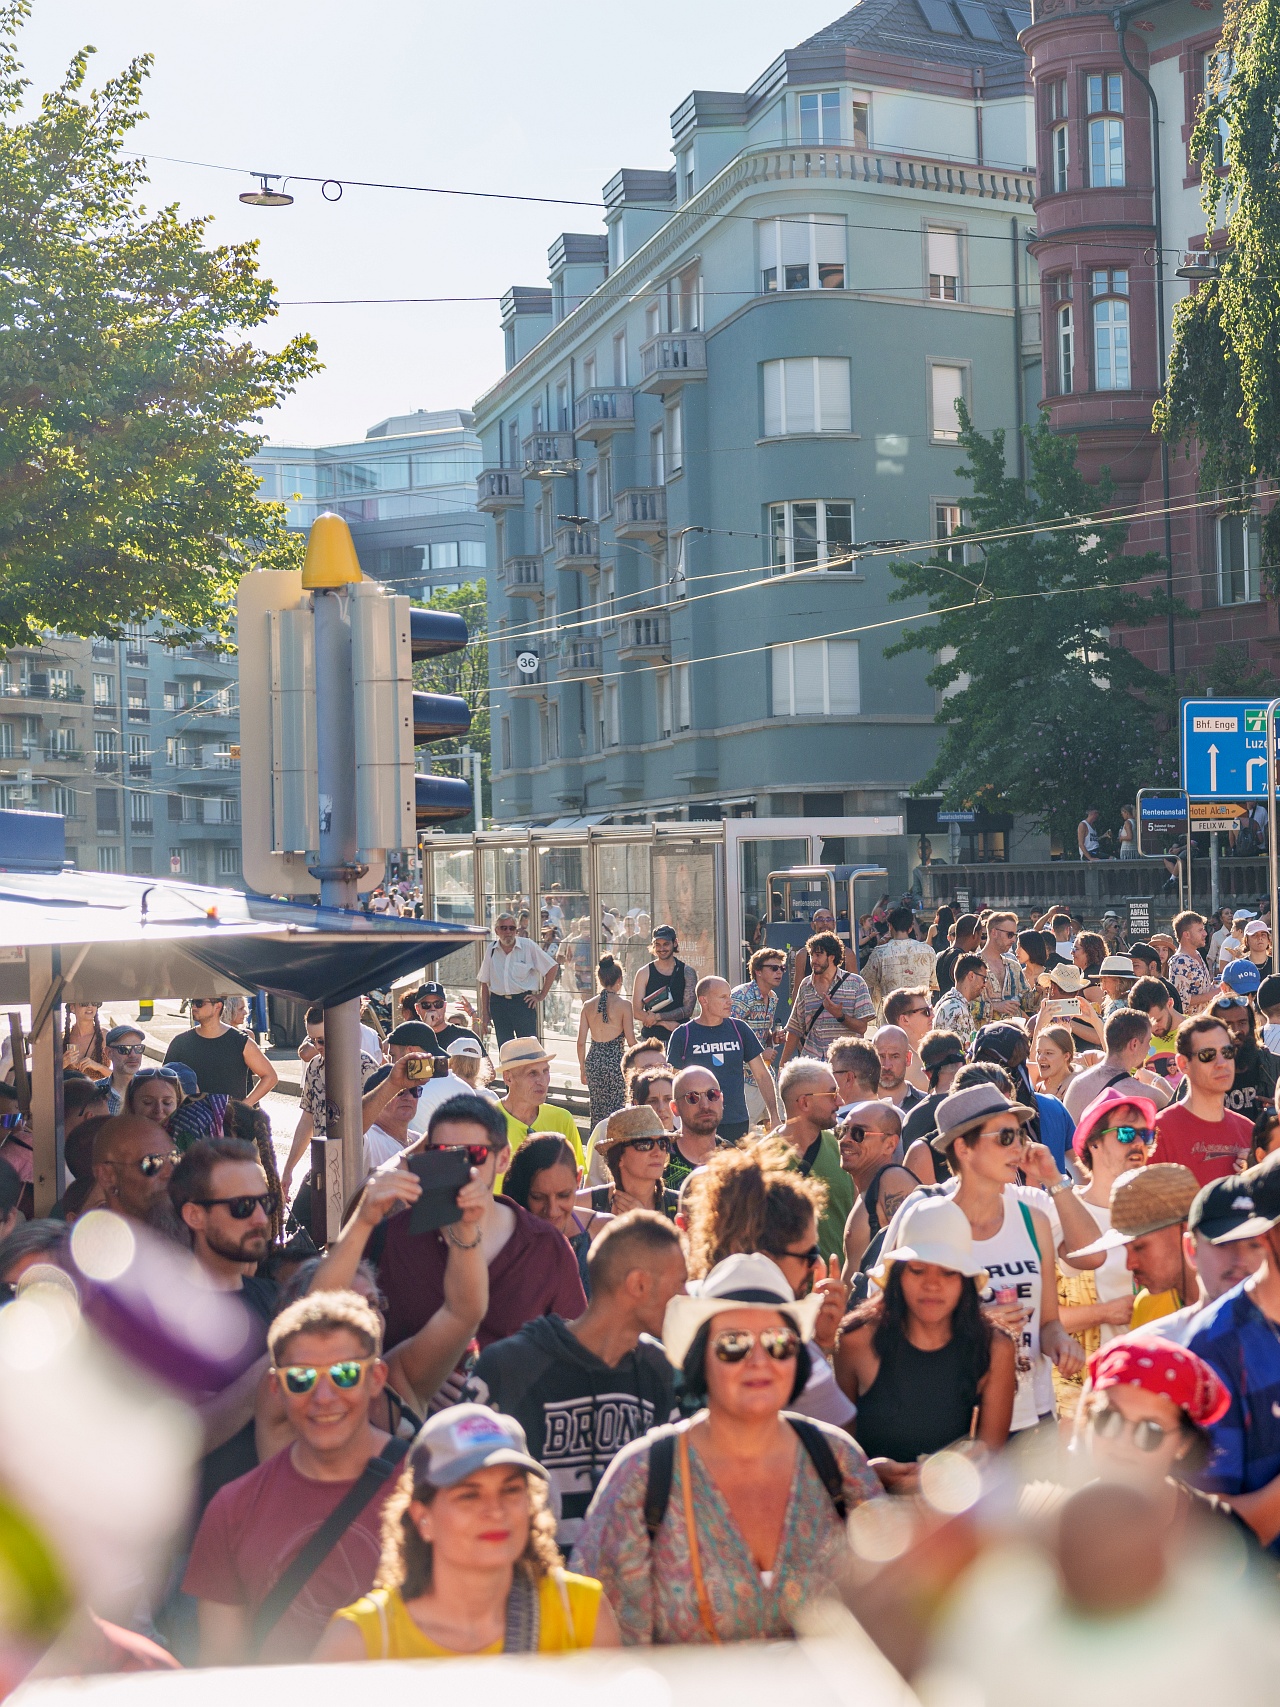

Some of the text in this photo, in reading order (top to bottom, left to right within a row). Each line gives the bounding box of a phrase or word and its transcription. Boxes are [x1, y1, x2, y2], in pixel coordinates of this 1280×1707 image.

[520, 657, 536, 668] 36
[1196, 720, 1235, 732] Bhf. Enge
[1142, 808, 1186, 816] Rentenanstalt
[1147, 822, 1154, 832] 5
[1198, 822, 1217, 830] FELIX
[1130, 908, 1149, 916] ABFALL
[1130, 919, 1150, 927] AUTRES
[692, 1040, 741, 1055] ZÜRICH
[982, 1260, 1040, 1279] RUE
